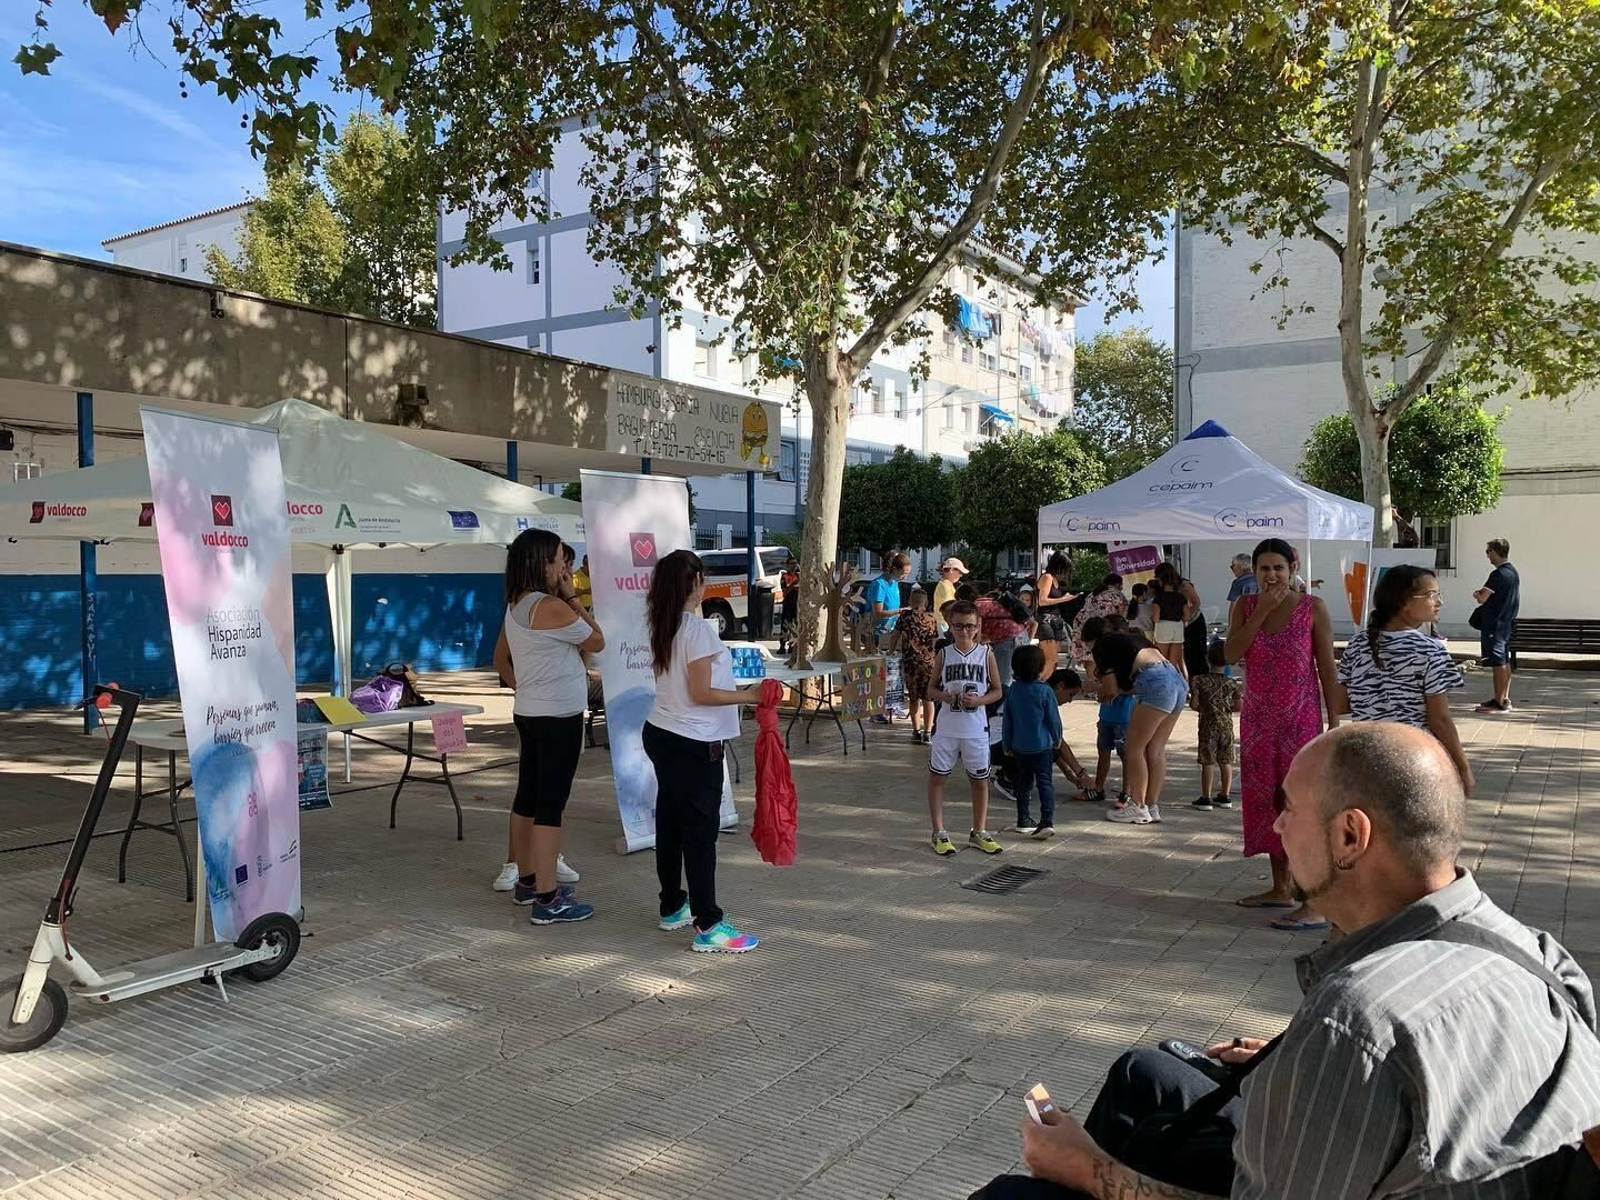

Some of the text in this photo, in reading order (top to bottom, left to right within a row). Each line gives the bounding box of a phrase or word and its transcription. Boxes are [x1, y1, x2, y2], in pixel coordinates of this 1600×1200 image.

[47, 503, 87, 517] valdocco
[201, 531, 249, 548] valdocco
[207, 605, 260, 623] Asociación
[208, 622, 262, 645] Hispanidad
[210, 644, 247, 661] Avanza
[856, 682, 872, 696] TU
[206, 705, 242, 726] Personas
